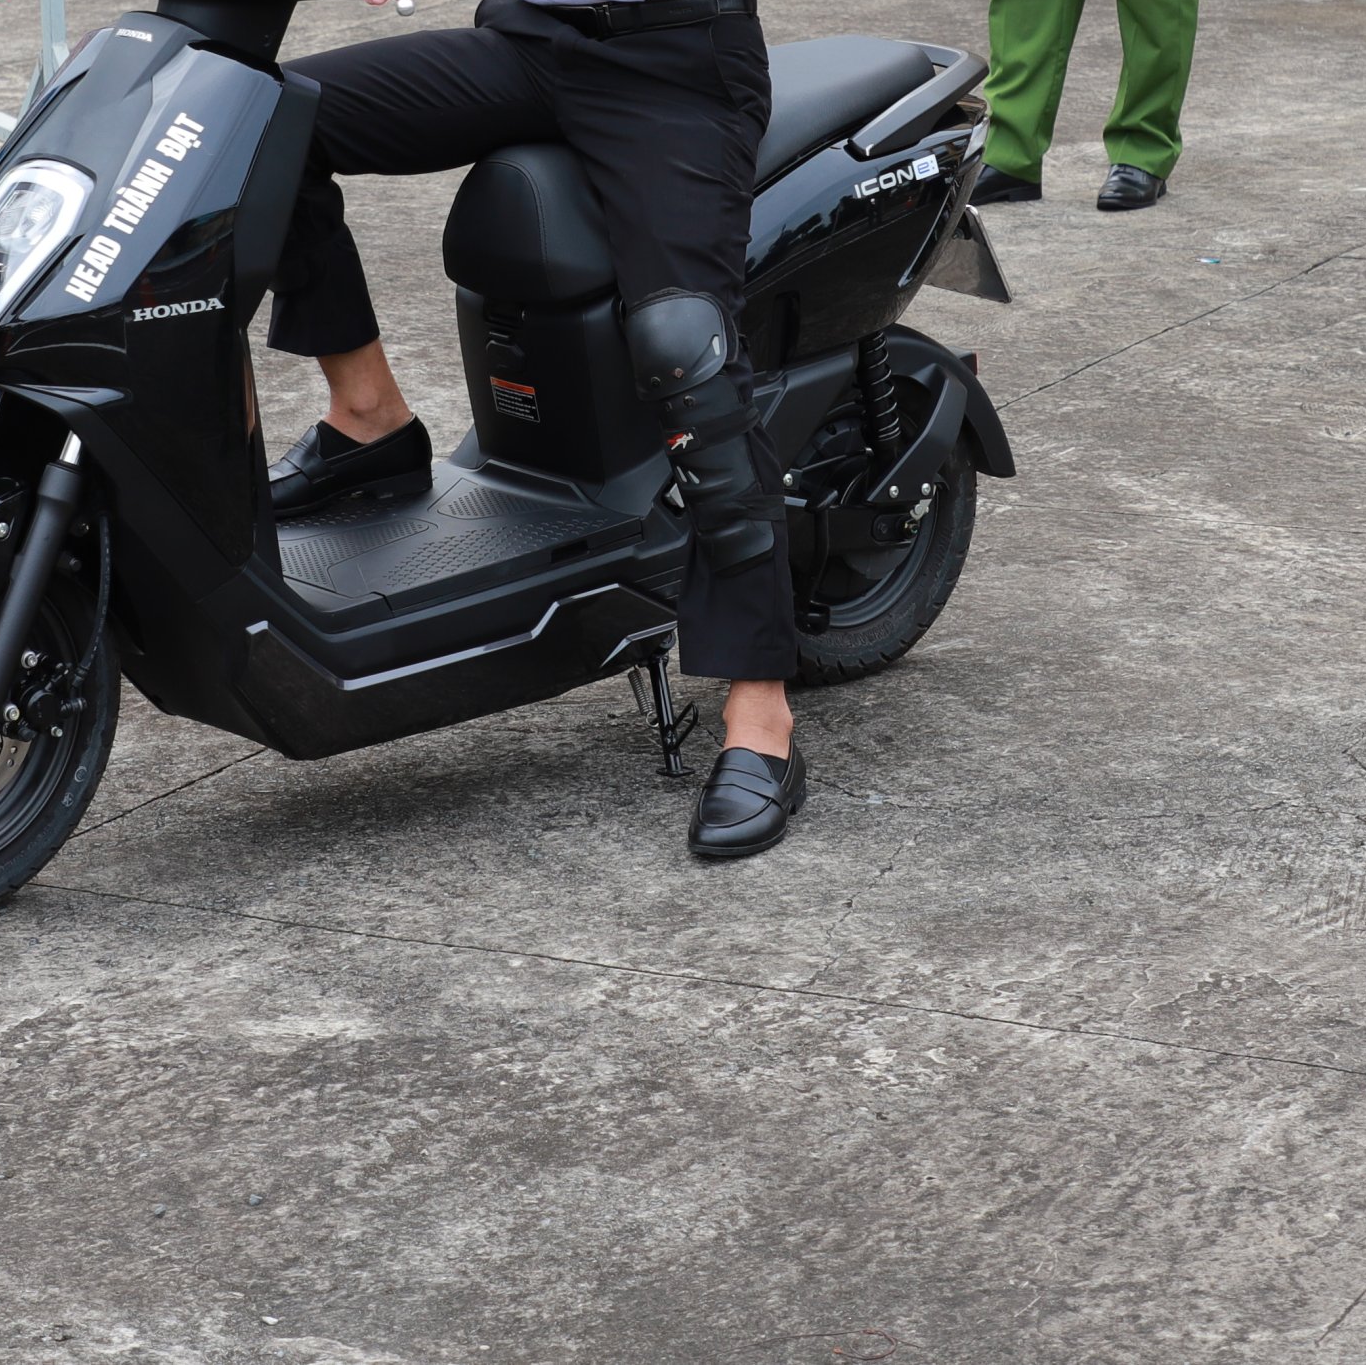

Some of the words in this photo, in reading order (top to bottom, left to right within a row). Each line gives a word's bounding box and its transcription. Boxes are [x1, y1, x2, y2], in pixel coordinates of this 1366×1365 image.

[65, 235, 122, 303] HEAD
[103, 159, 174, 235] THÀNH
[156, 112, 205, 161] ĐẠT
[133, 297, 225, 322] HONDA
